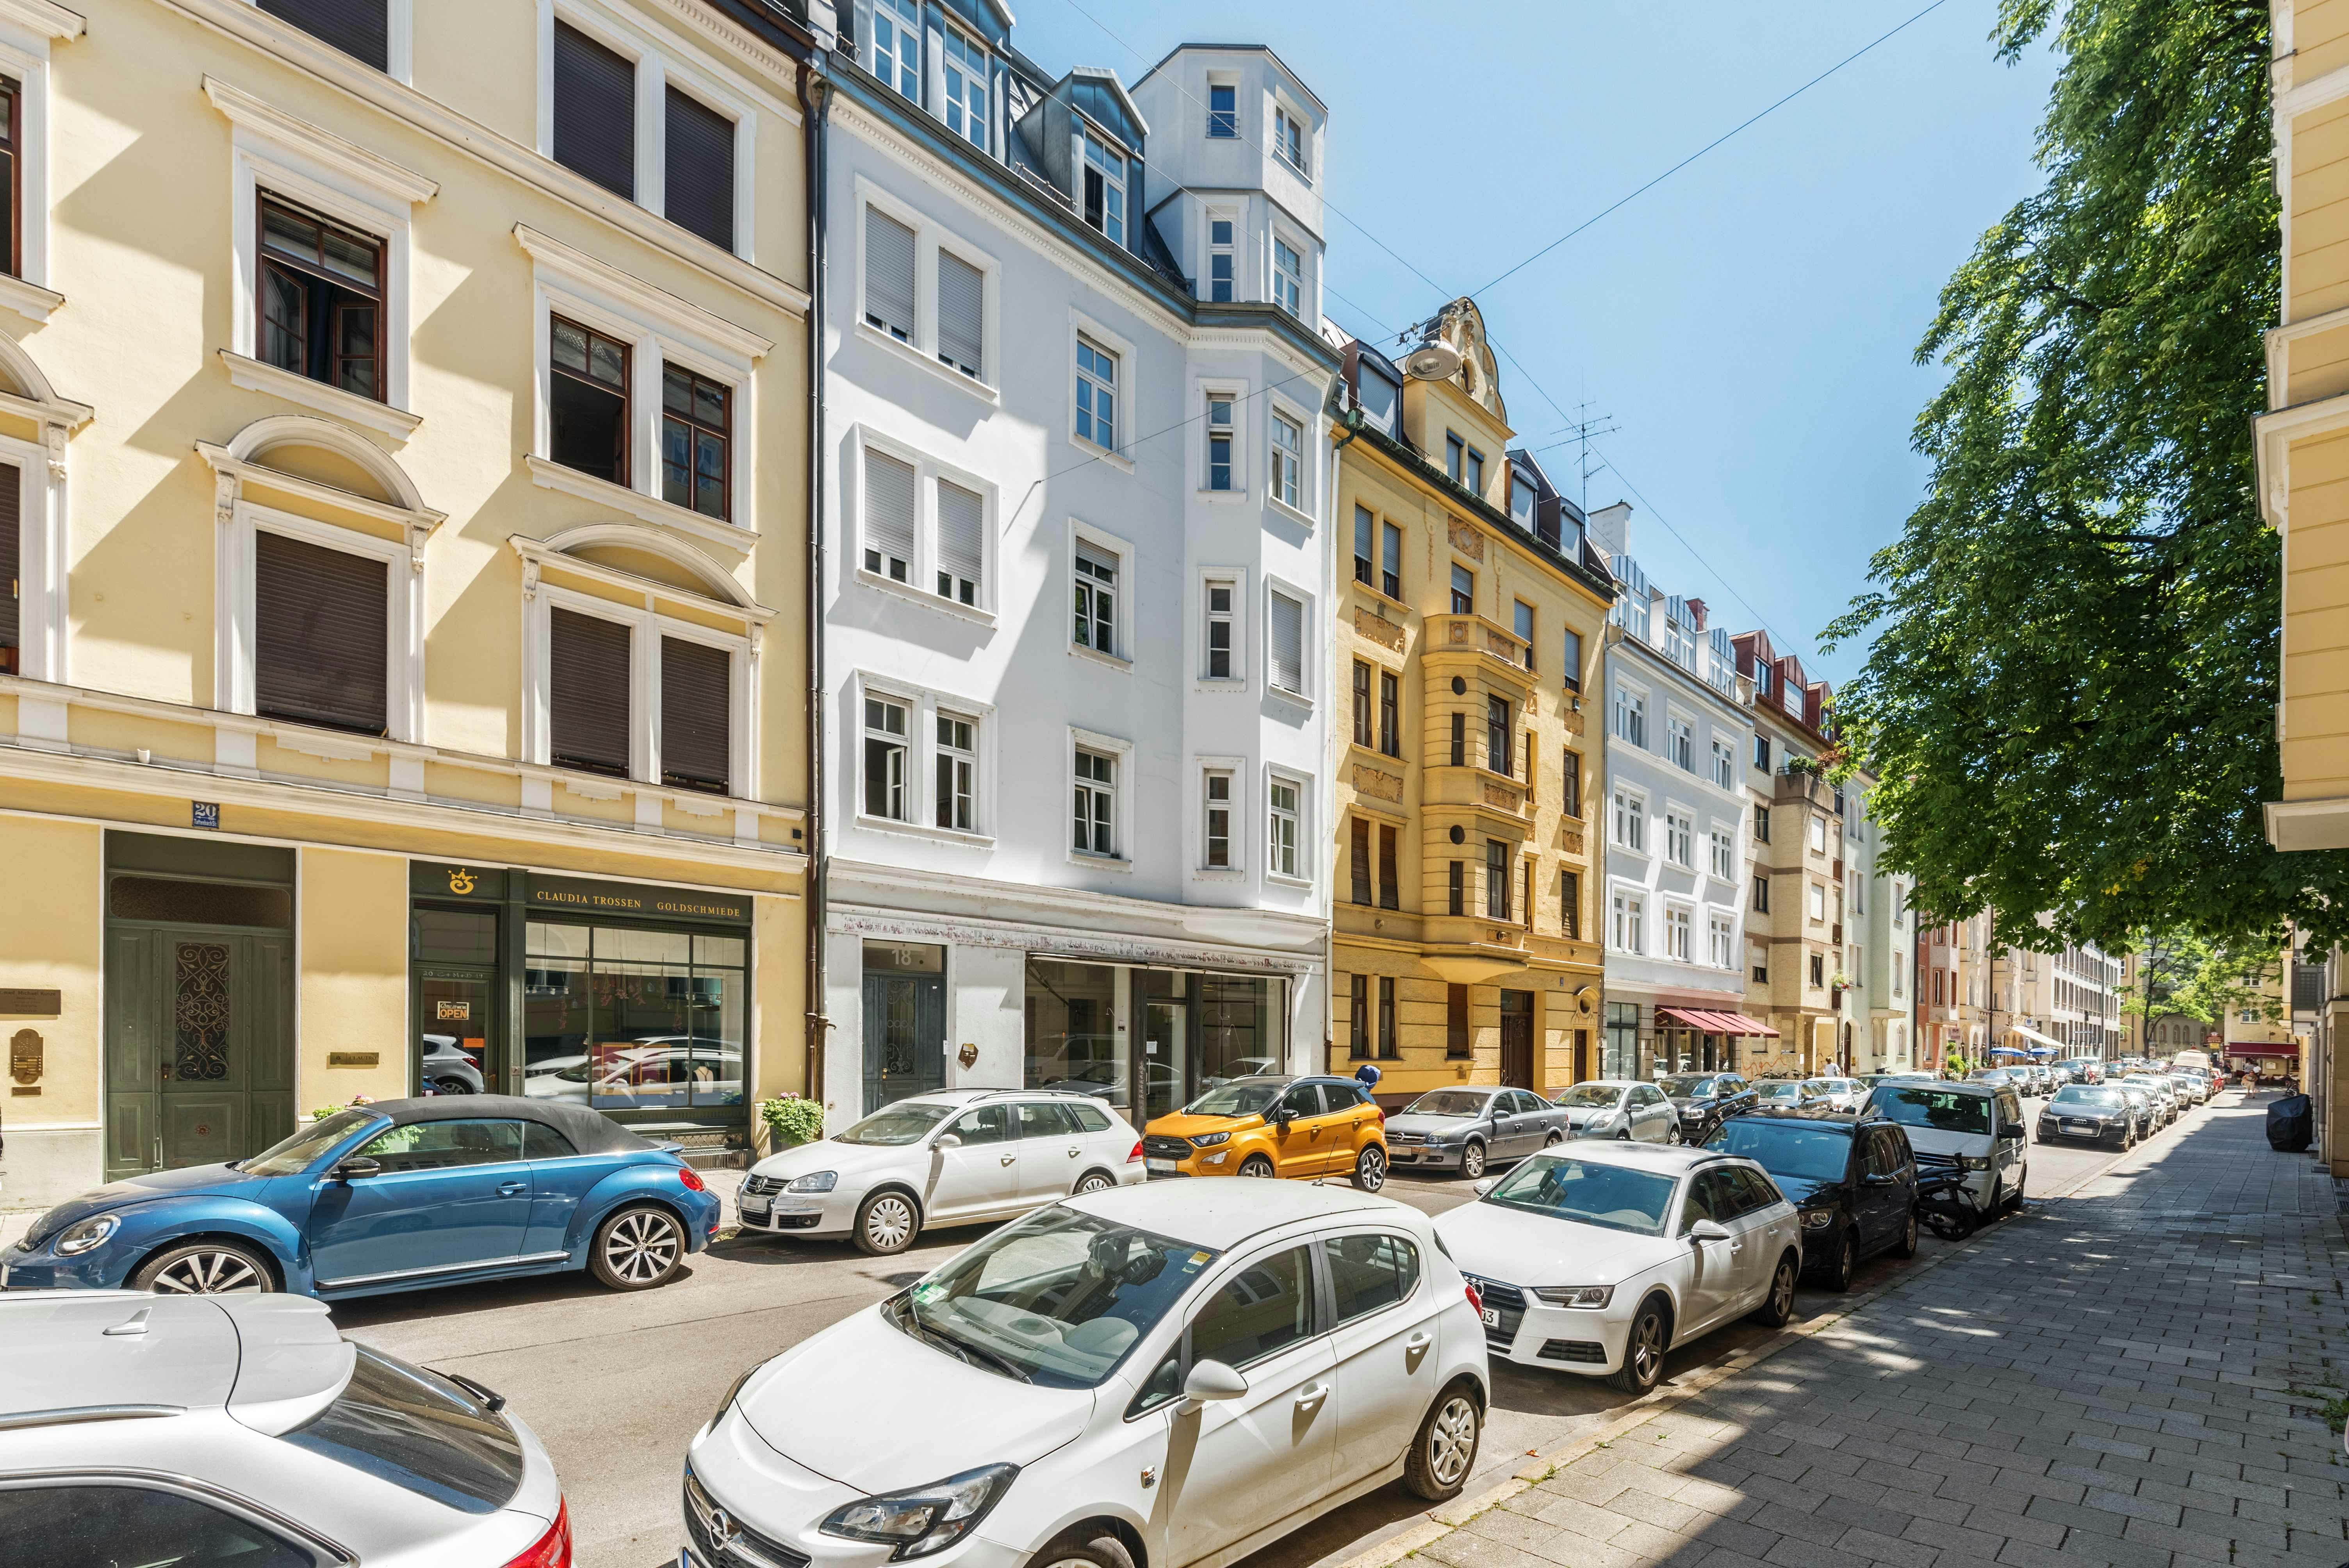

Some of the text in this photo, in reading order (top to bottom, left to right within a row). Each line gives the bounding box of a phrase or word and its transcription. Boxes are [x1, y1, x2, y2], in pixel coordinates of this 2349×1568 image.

[195, 804, 216, 817] 20
[537, 891, 740, 916] CLAUDIA TROSSEN GOLDSCHMIEDE
[892, 949, 911, 965] 18
[440, 1009, 466, 1018] OPEN
